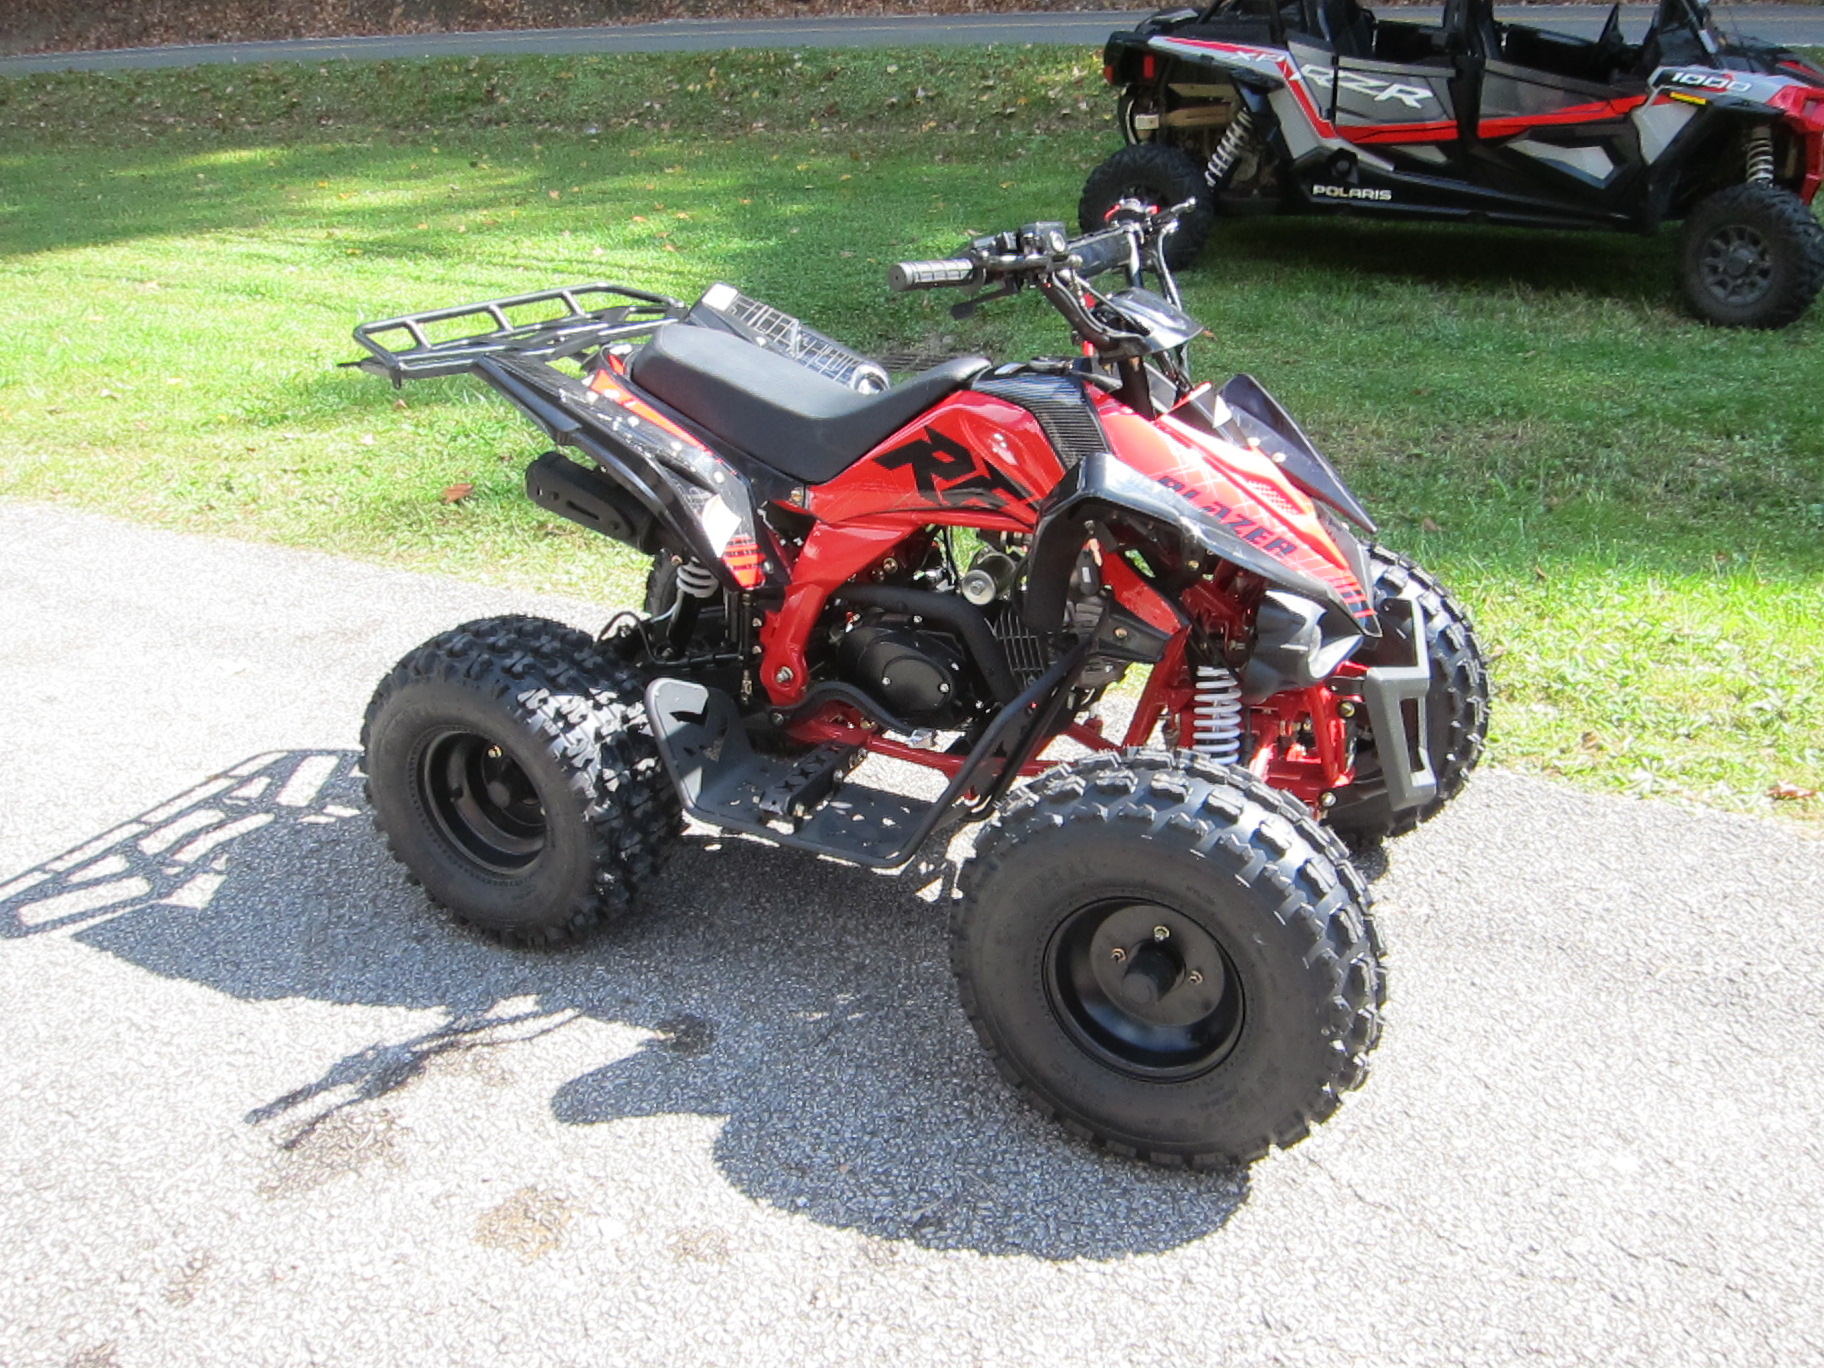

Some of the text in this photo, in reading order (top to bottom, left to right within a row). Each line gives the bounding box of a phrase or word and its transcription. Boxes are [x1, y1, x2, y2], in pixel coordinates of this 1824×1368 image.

[1289, 64, 1434, 109] RZR
[1671, 72, 1753, 93] 1000
[1312, 184, 1392, 201] POLARIS
